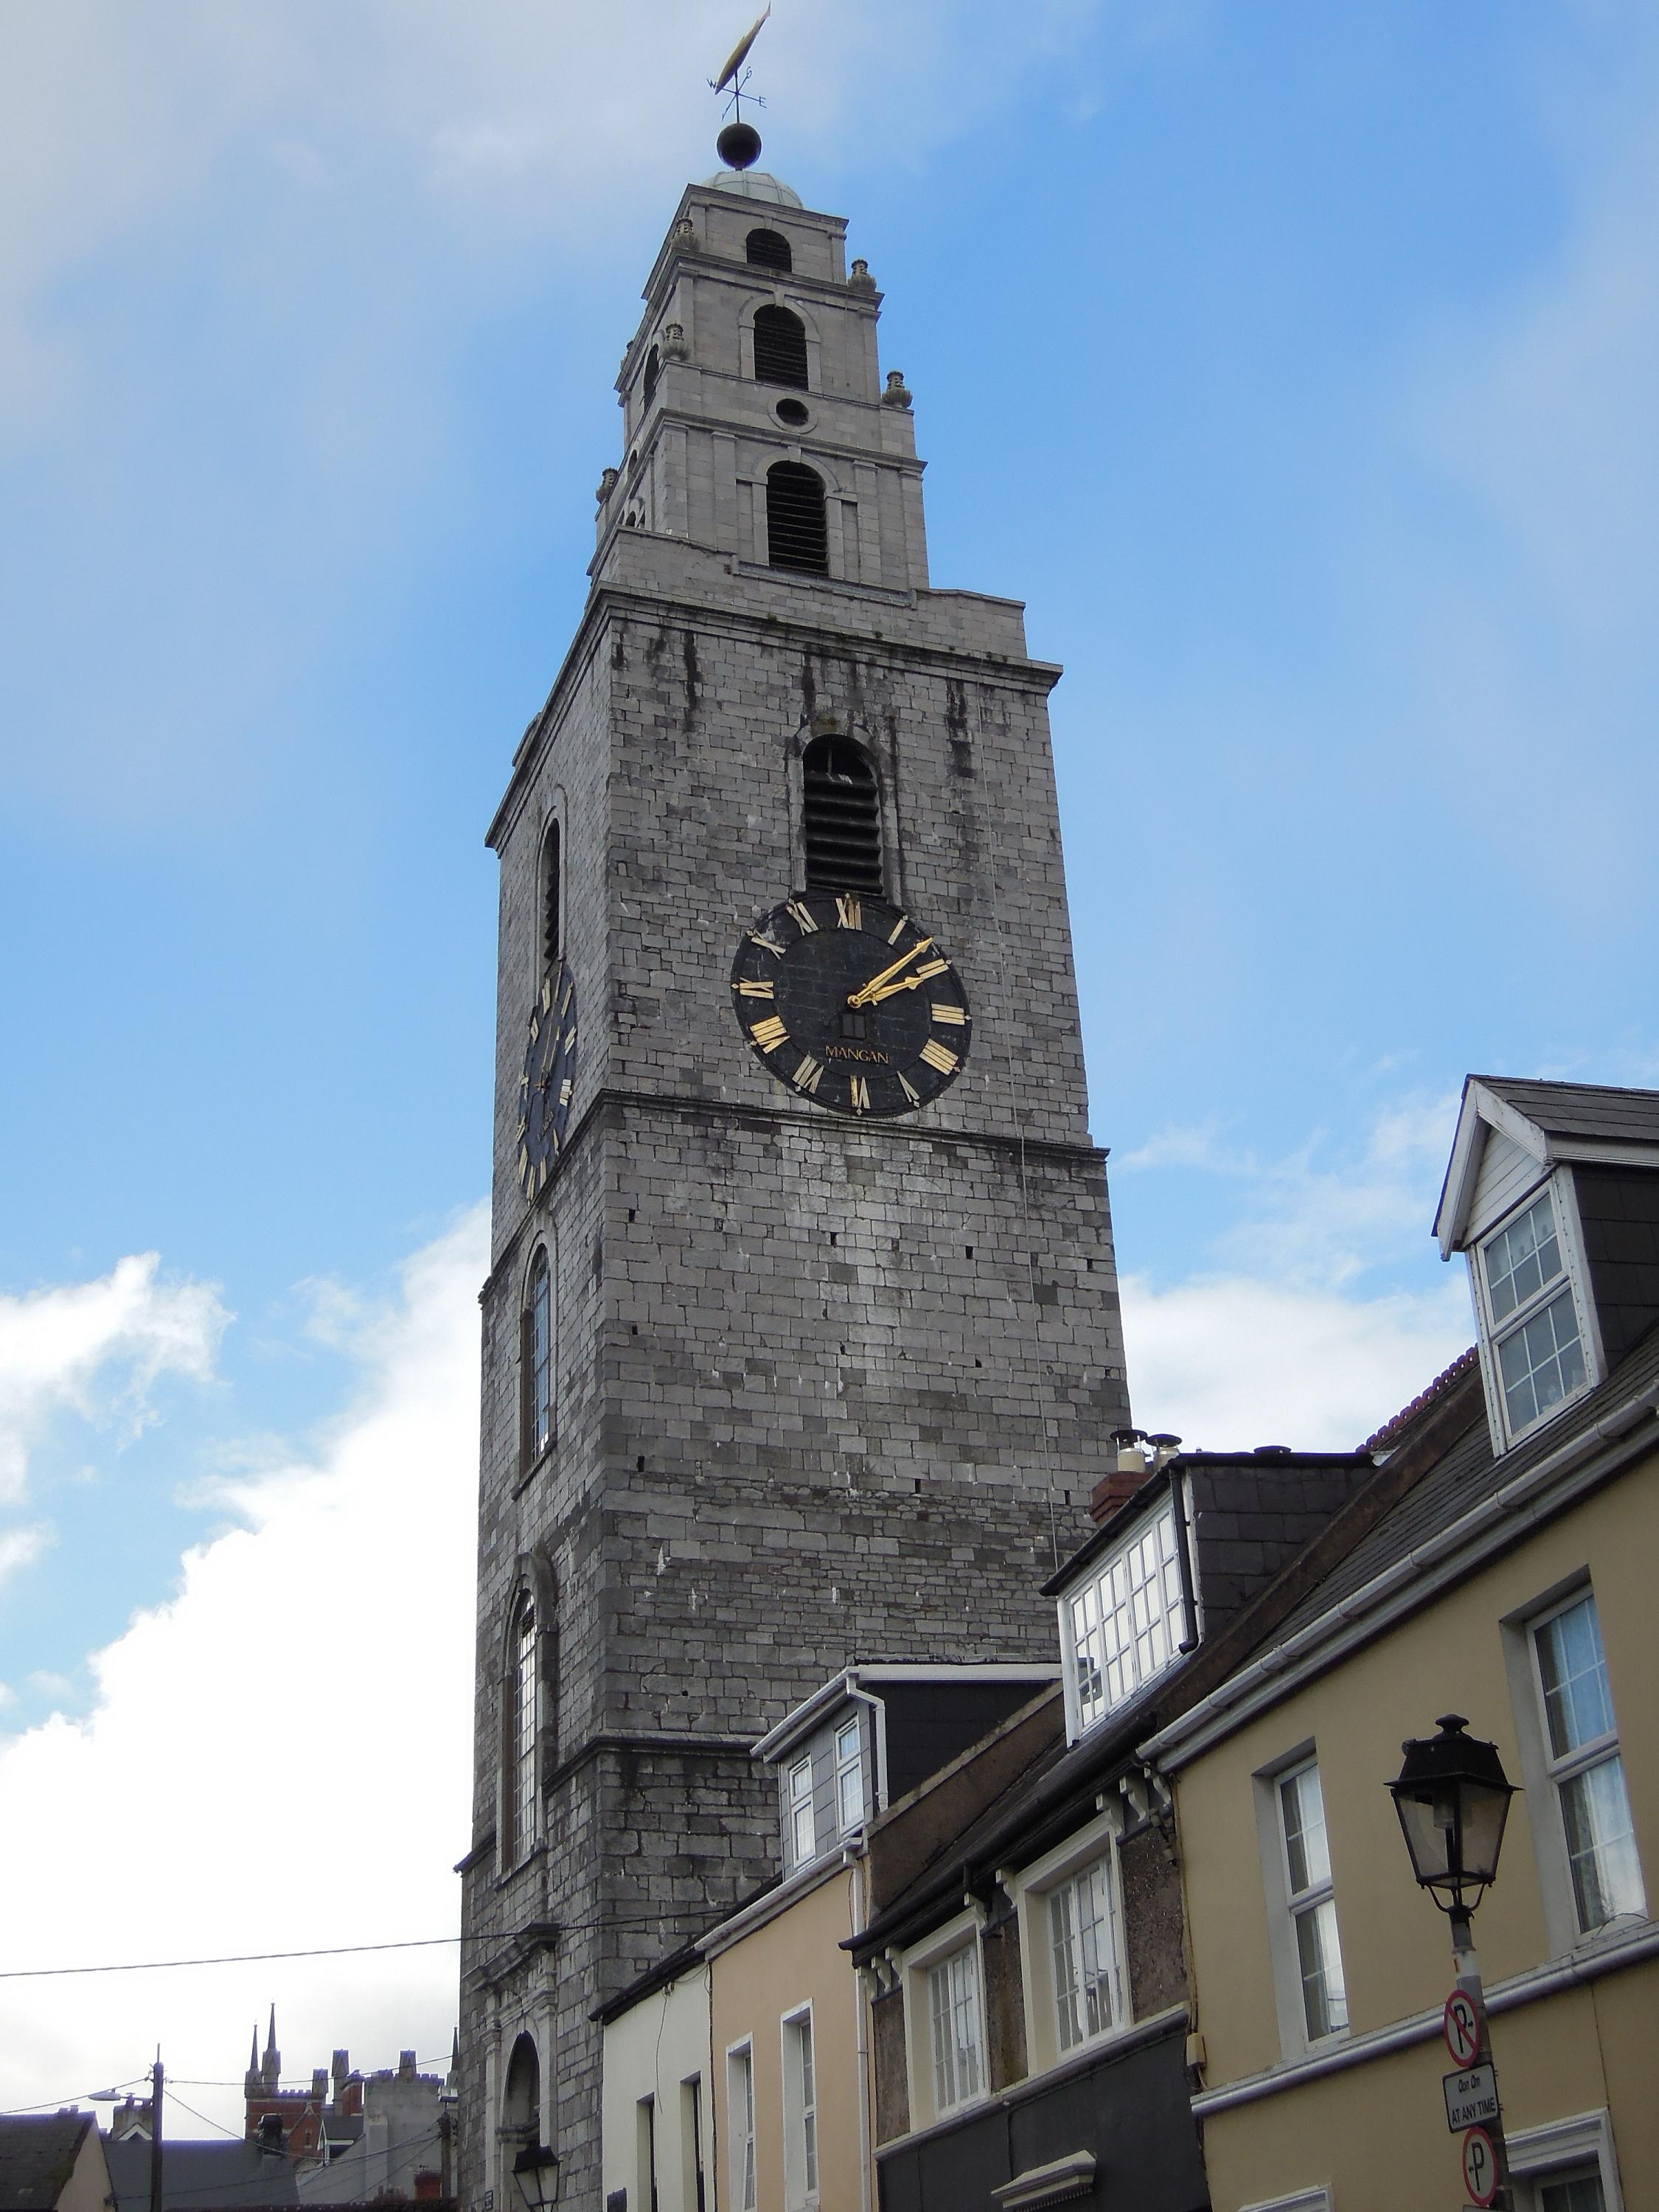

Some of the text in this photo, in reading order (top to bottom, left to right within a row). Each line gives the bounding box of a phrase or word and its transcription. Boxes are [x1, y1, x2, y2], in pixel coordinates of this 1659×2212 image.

[785, 902, 818, 936] XI
[835, 897, 862, 931] XII
[916, 958, 949, 980] II
[740, 977, 774, 999] IX
[931, 1003, 965, 1025] III
[749, 1015, 790, 1054] VIII
[825, 1046, 889, 1064] MANGAN
[792, 1054, 824, 1093] VII
[897, 1071, 920, 1103] V
[850, 1074, 871, 1109] VI
[1453, 2003, 1467, 2053] P
[1452, 2096, 1496, 2124] AT ANY TIME
[1471, 2141, 1485, 2191] P
